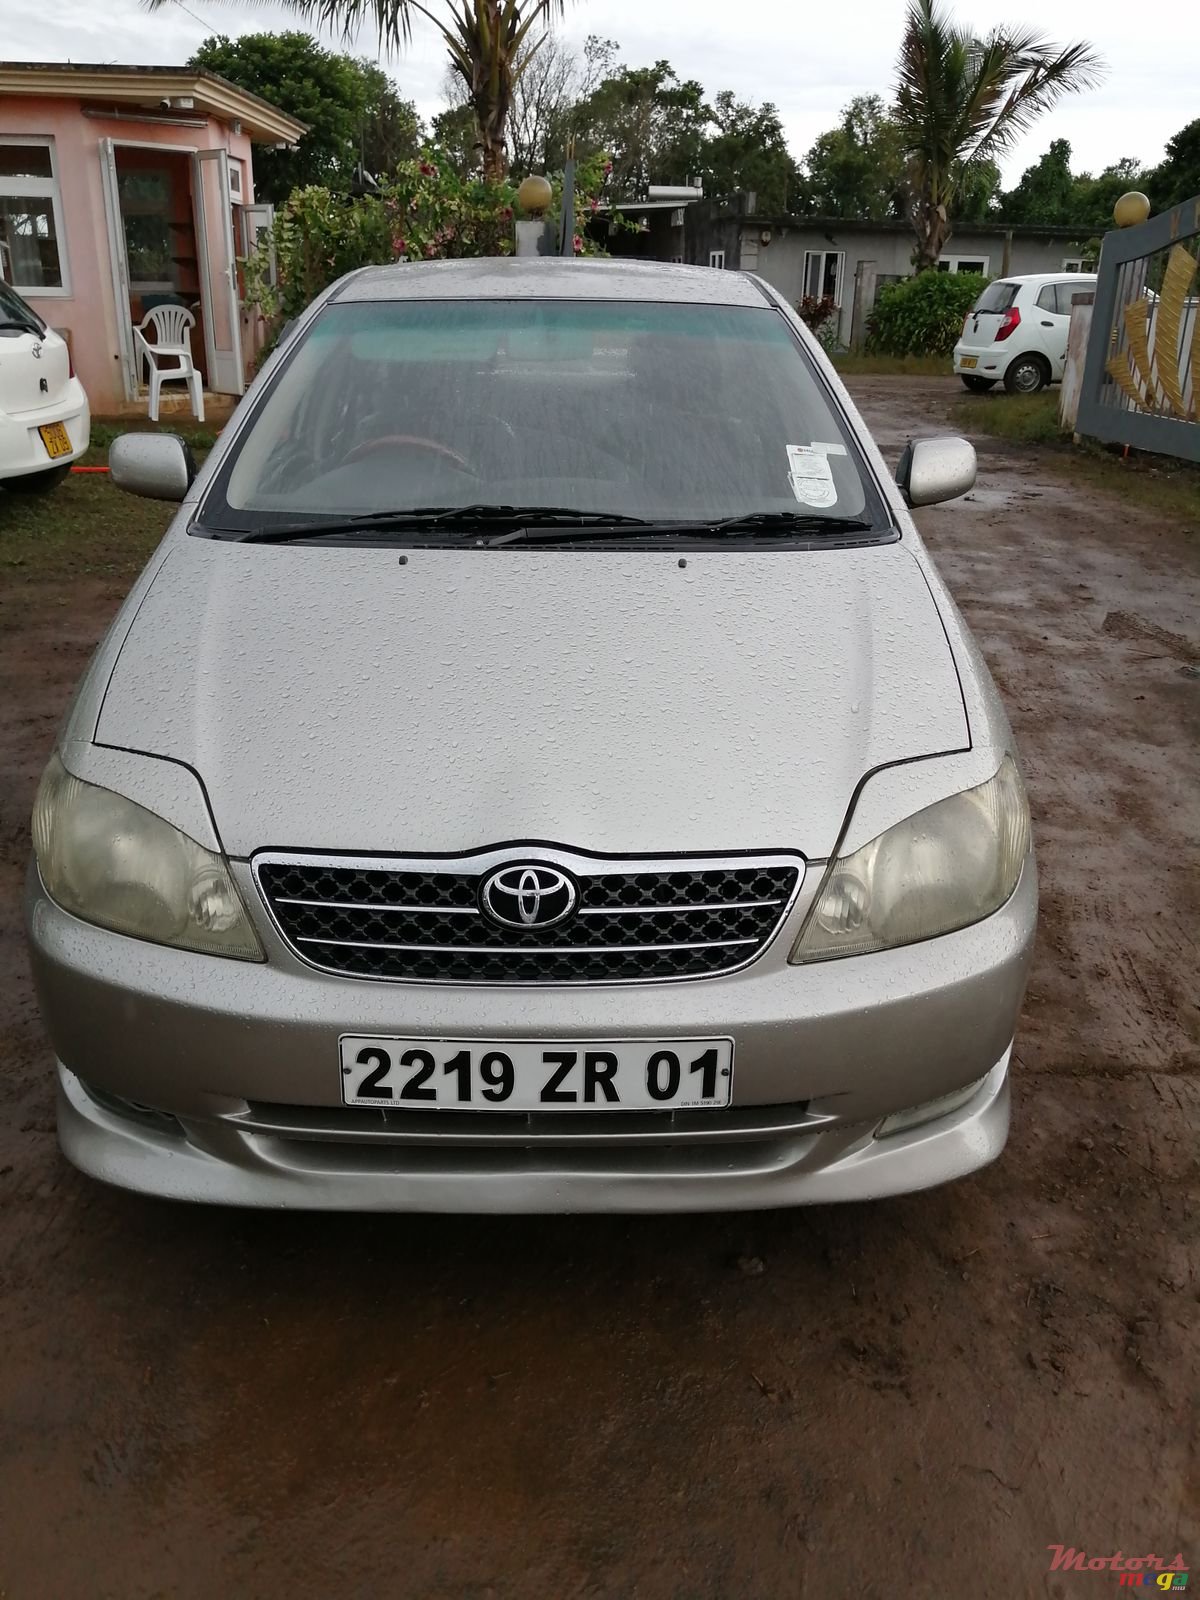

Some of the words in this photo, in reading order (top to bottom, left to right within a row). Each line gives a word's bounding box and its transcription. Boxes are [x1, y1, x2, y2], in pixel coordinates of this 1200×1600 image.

[355, 1047, 515, 1102] 2219
[540, 1051, 621, 1103] ZR
[646, 1048, 719, 1102] 01
